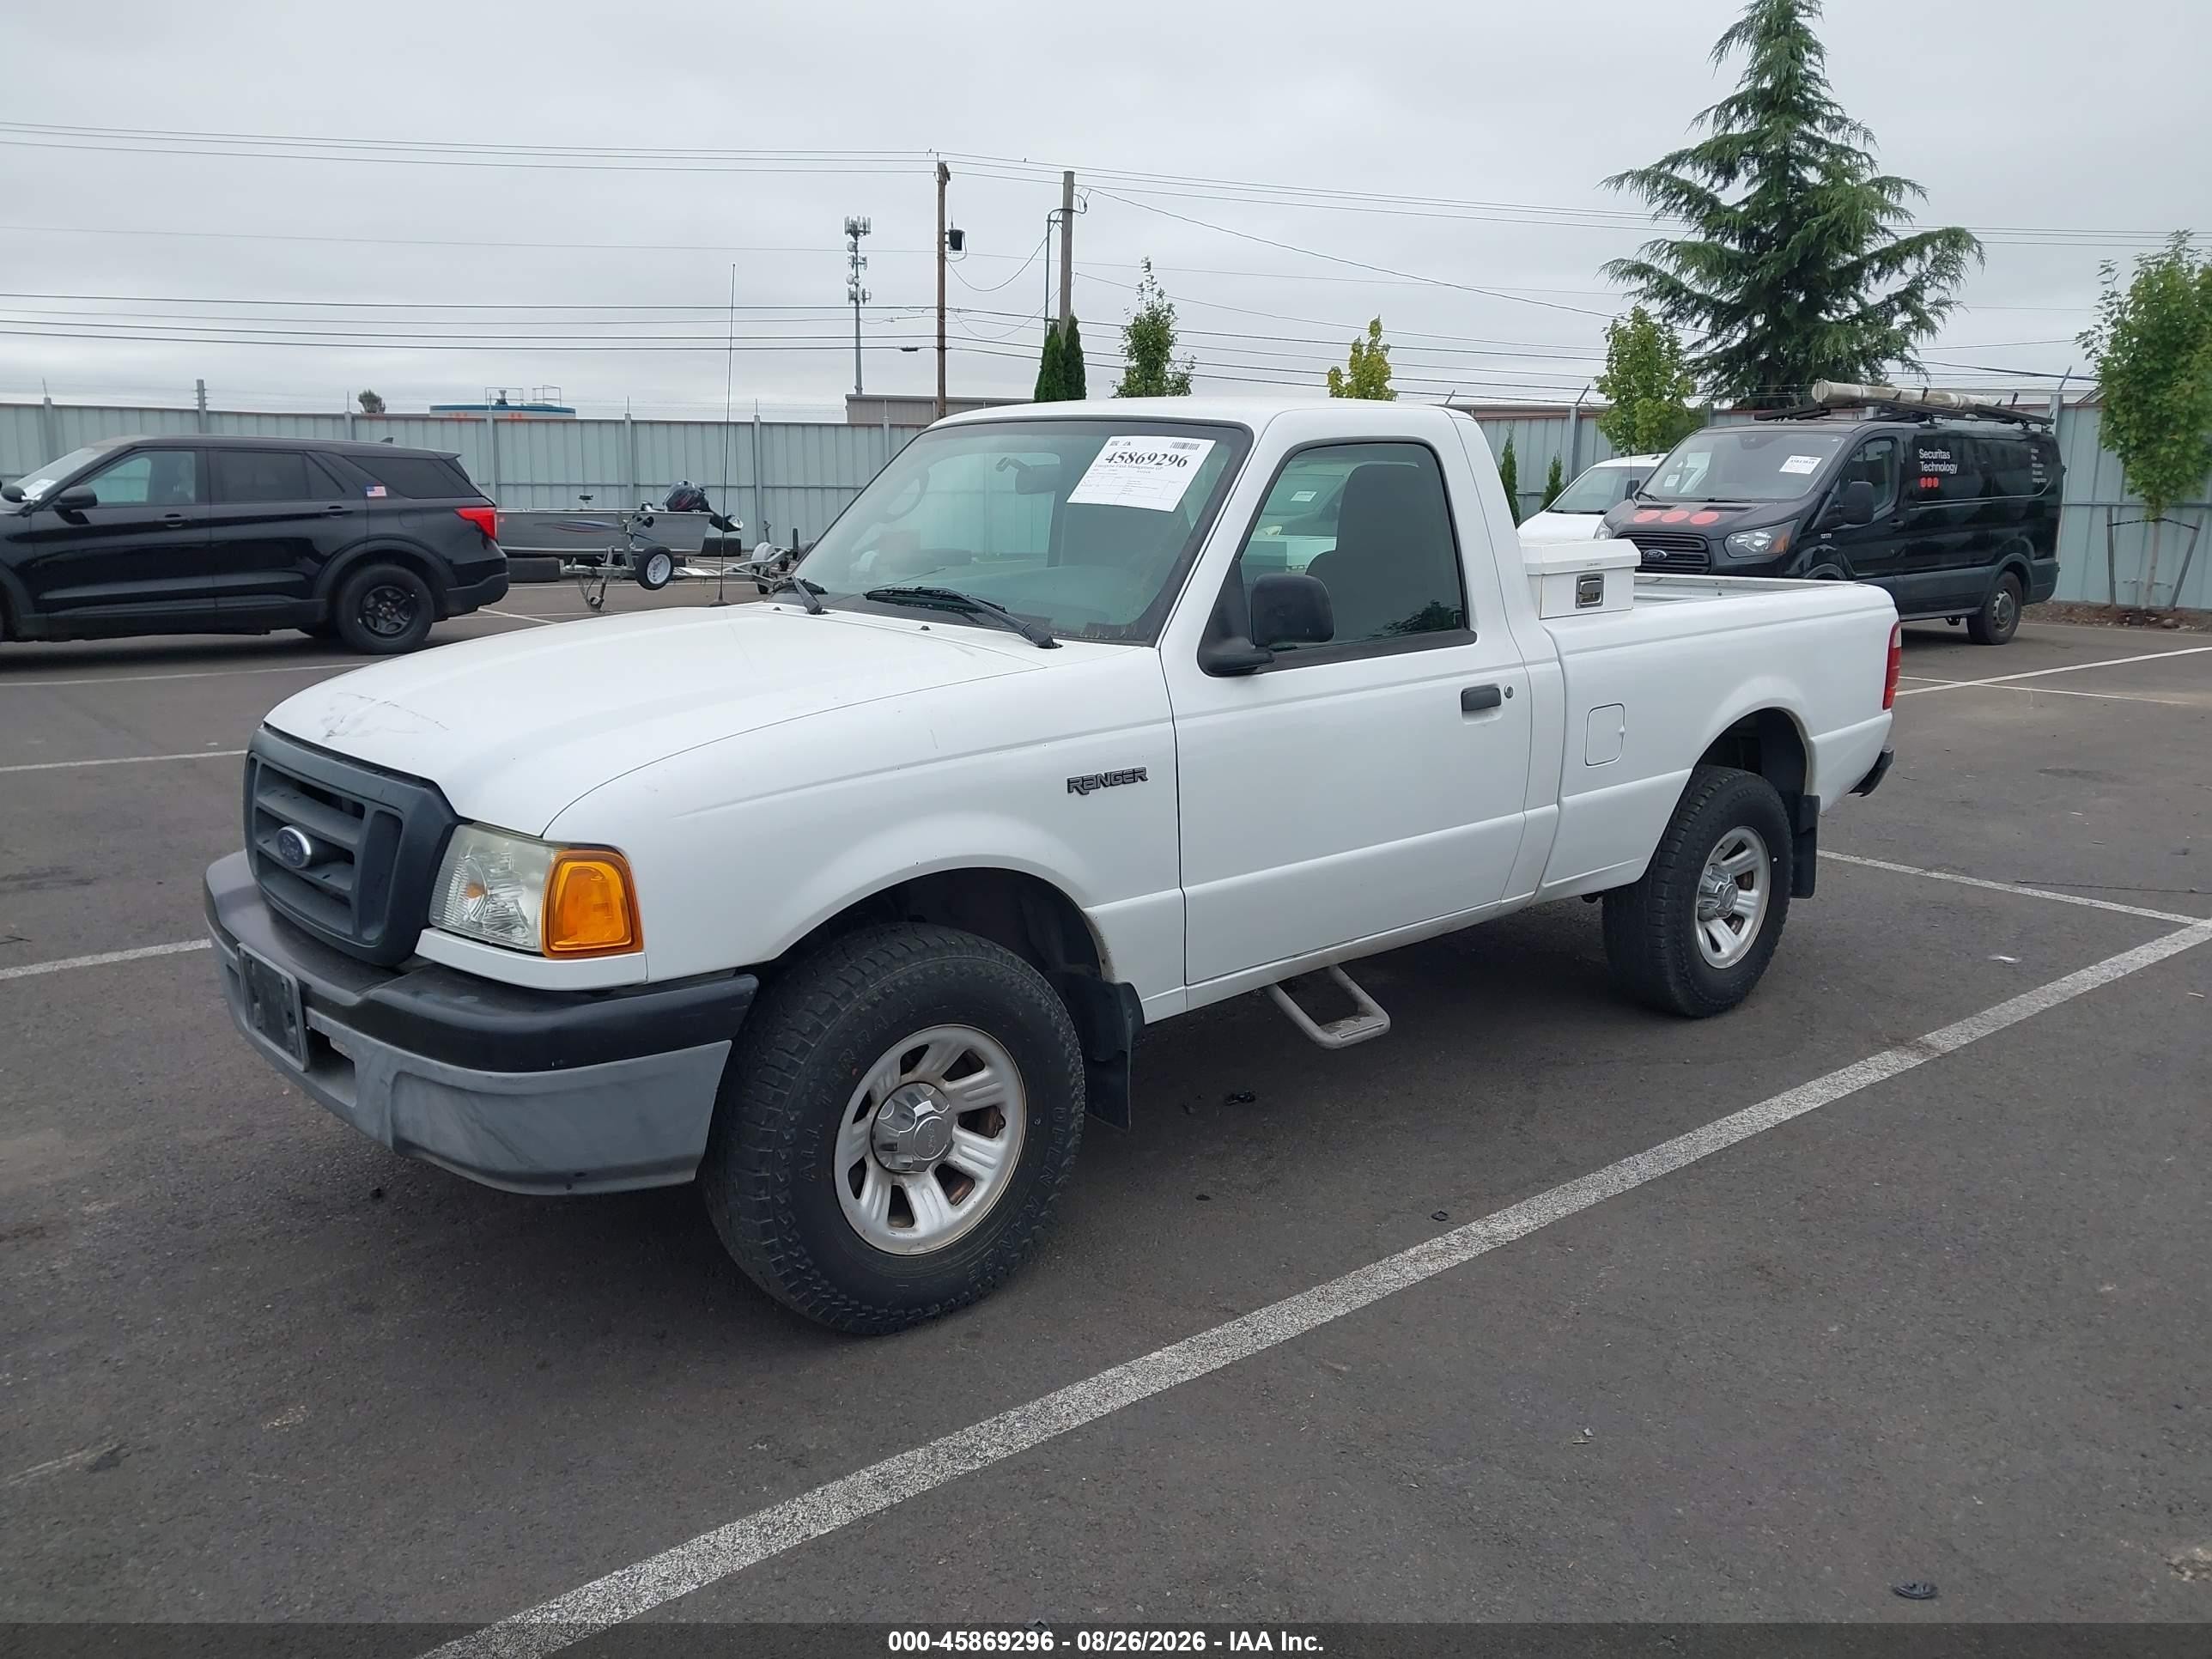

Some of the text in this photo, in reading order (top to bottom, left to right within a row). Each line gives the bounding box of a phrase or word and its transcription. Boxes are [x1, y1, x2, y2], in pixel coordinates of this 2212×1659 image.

[1105, 451, 1192, 468] 45869296
[1919, 447, 1951, 459] Securitas
[1919, 460, 1958, 474] Technology
[1066, 767, 1148, 795] RANGER
